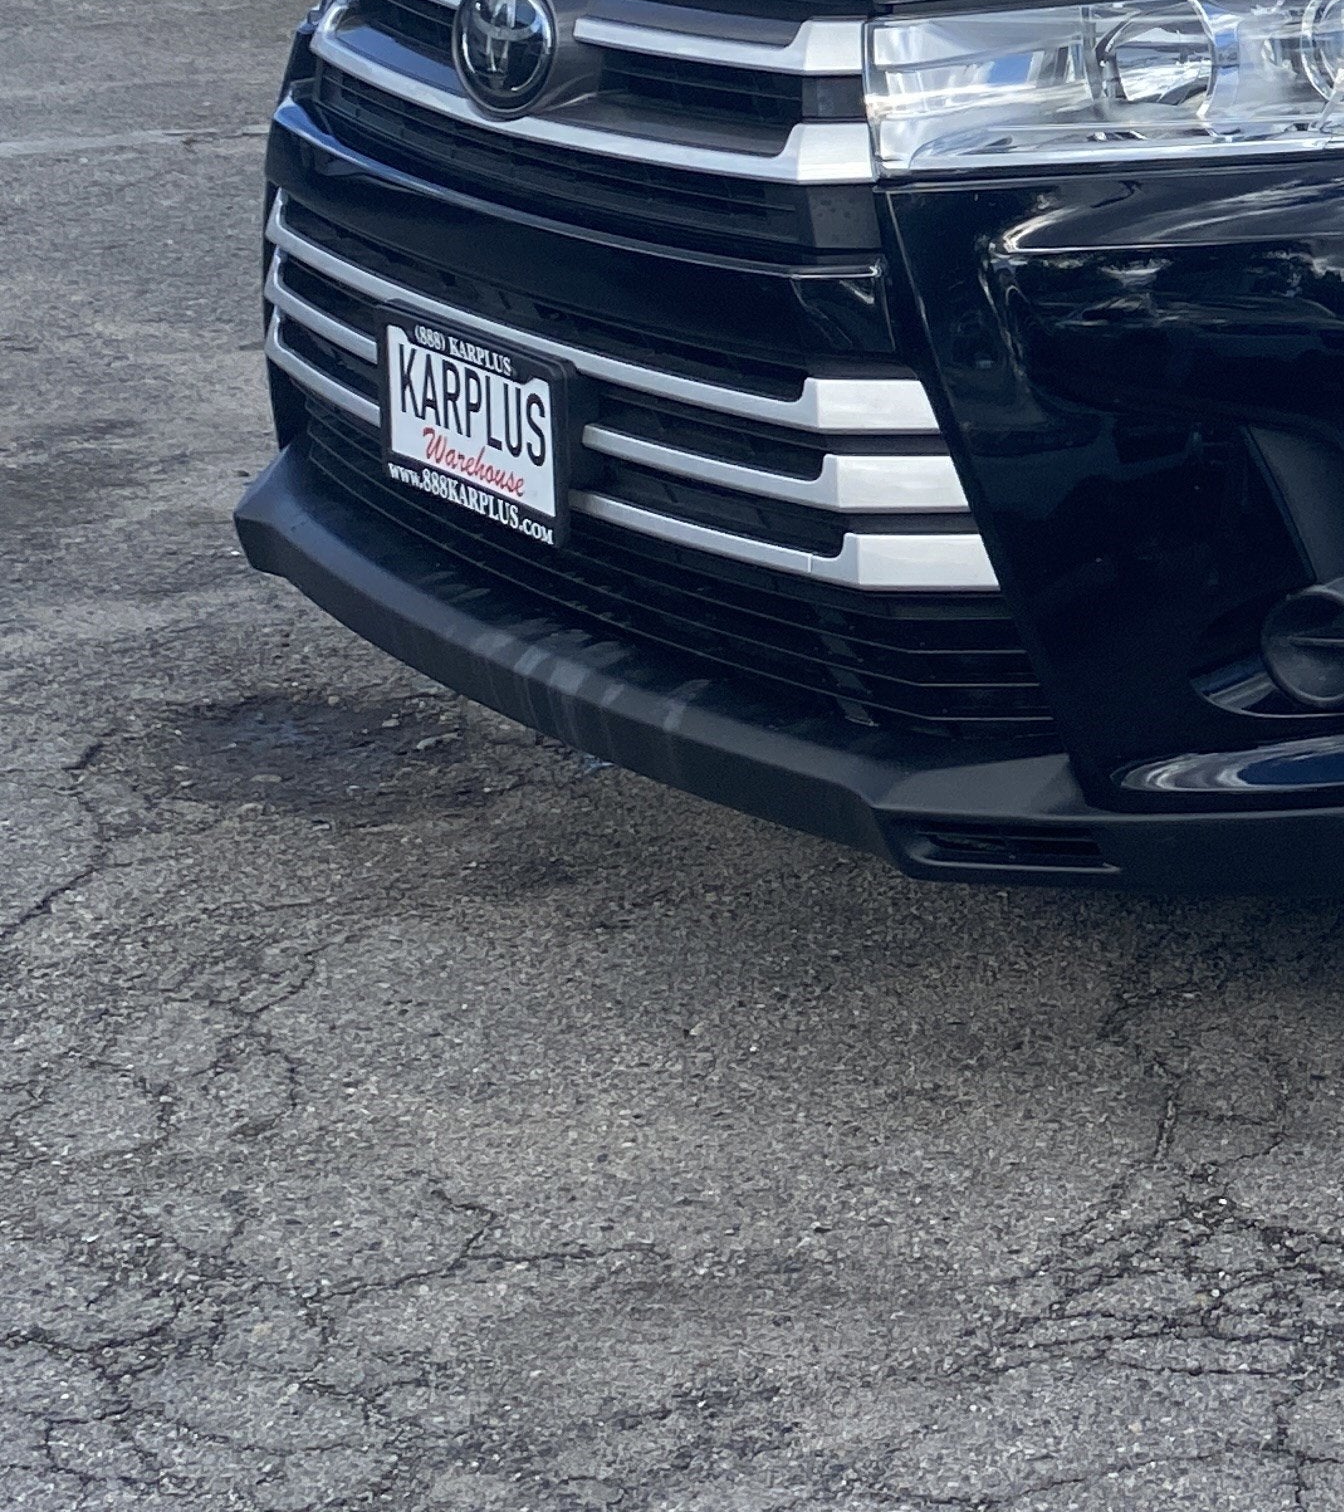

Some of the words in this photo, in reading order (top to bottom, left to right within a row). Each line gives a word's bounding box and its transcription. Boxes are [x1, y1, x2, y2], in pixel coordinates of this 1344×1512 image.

[414, 324, 446, 351] (888)
[449, 337, 512, 377] KARPLUS
[399, 343, 547, 467] KARPLUS
[422, 426, 525, 498] Warehouse
